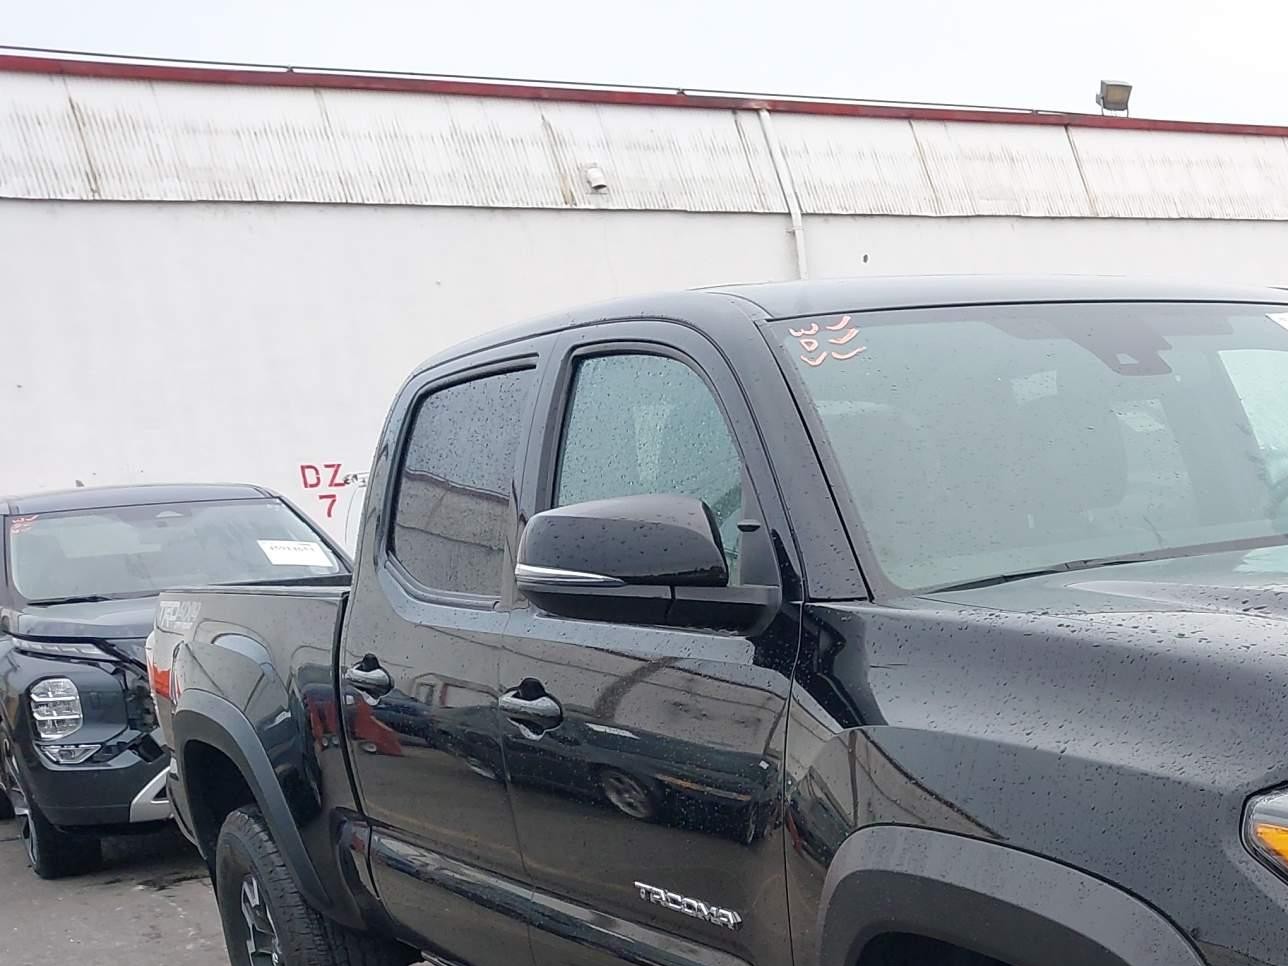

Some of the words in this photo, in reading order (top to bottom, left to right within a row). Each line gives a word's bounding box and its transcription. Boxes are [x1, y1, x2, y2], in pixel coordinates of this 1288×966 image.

[300, 463, 345, 488] DZ
[319, 494, 337, 518] 7
[633, 881, 742, 930] TACOMA
